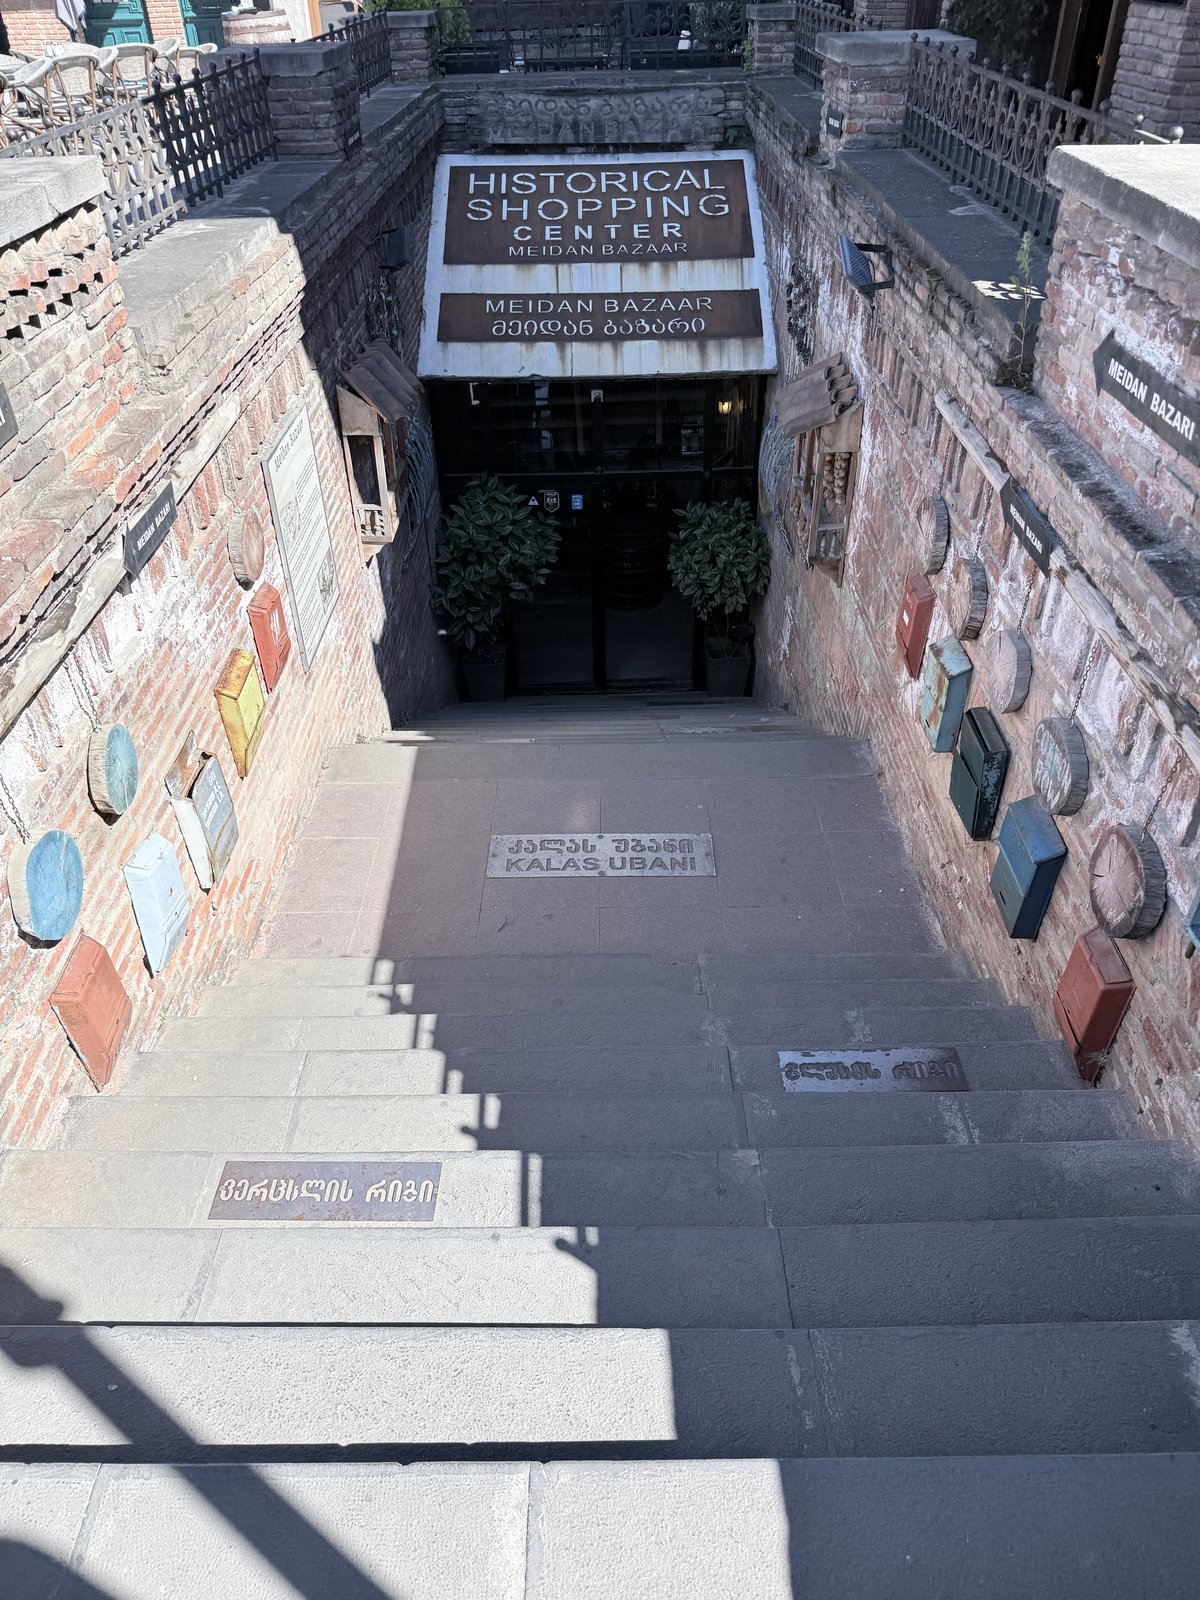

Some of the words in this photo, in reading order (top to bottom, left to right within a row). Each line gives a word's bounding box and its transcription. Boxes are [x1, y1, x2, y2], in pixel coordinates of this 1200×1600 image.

[468, 168, 726, 195] HISTORICAL
[466, 194, 730, 221] SHOPPING
[513, 222, 683, 241] CENTER
[508, 245, 593, 257] MEIDAN
[601, 242, 687, 255] BAZAAR
[485, 299, 593, 314] MEIDAN
[604, 296, 713, 313] BAZAAR
[491, 319, 593, 337] მეიდან
[603, 317, 706, 336] ბაზარი
[1108, 357, 1148, 403] MEIDAN
[1150, 392, 1196, 441] BAZARI
[136, 522, 156, 552] MEIDAN
[154, 501, 171, 528] BAZARI
[1009, 503, 1026, 531] MEIDAN
[1025, 524, 1043, 554] BAZARI
[507, 838, 597, 854] კალას
[505, 857, 600, 872] KALAS
[609, 856, 697, 871] UBANI
[218, 1177, 355, 1203] ვერცხლის
[364, 1178, 435, 1203] რიგი
